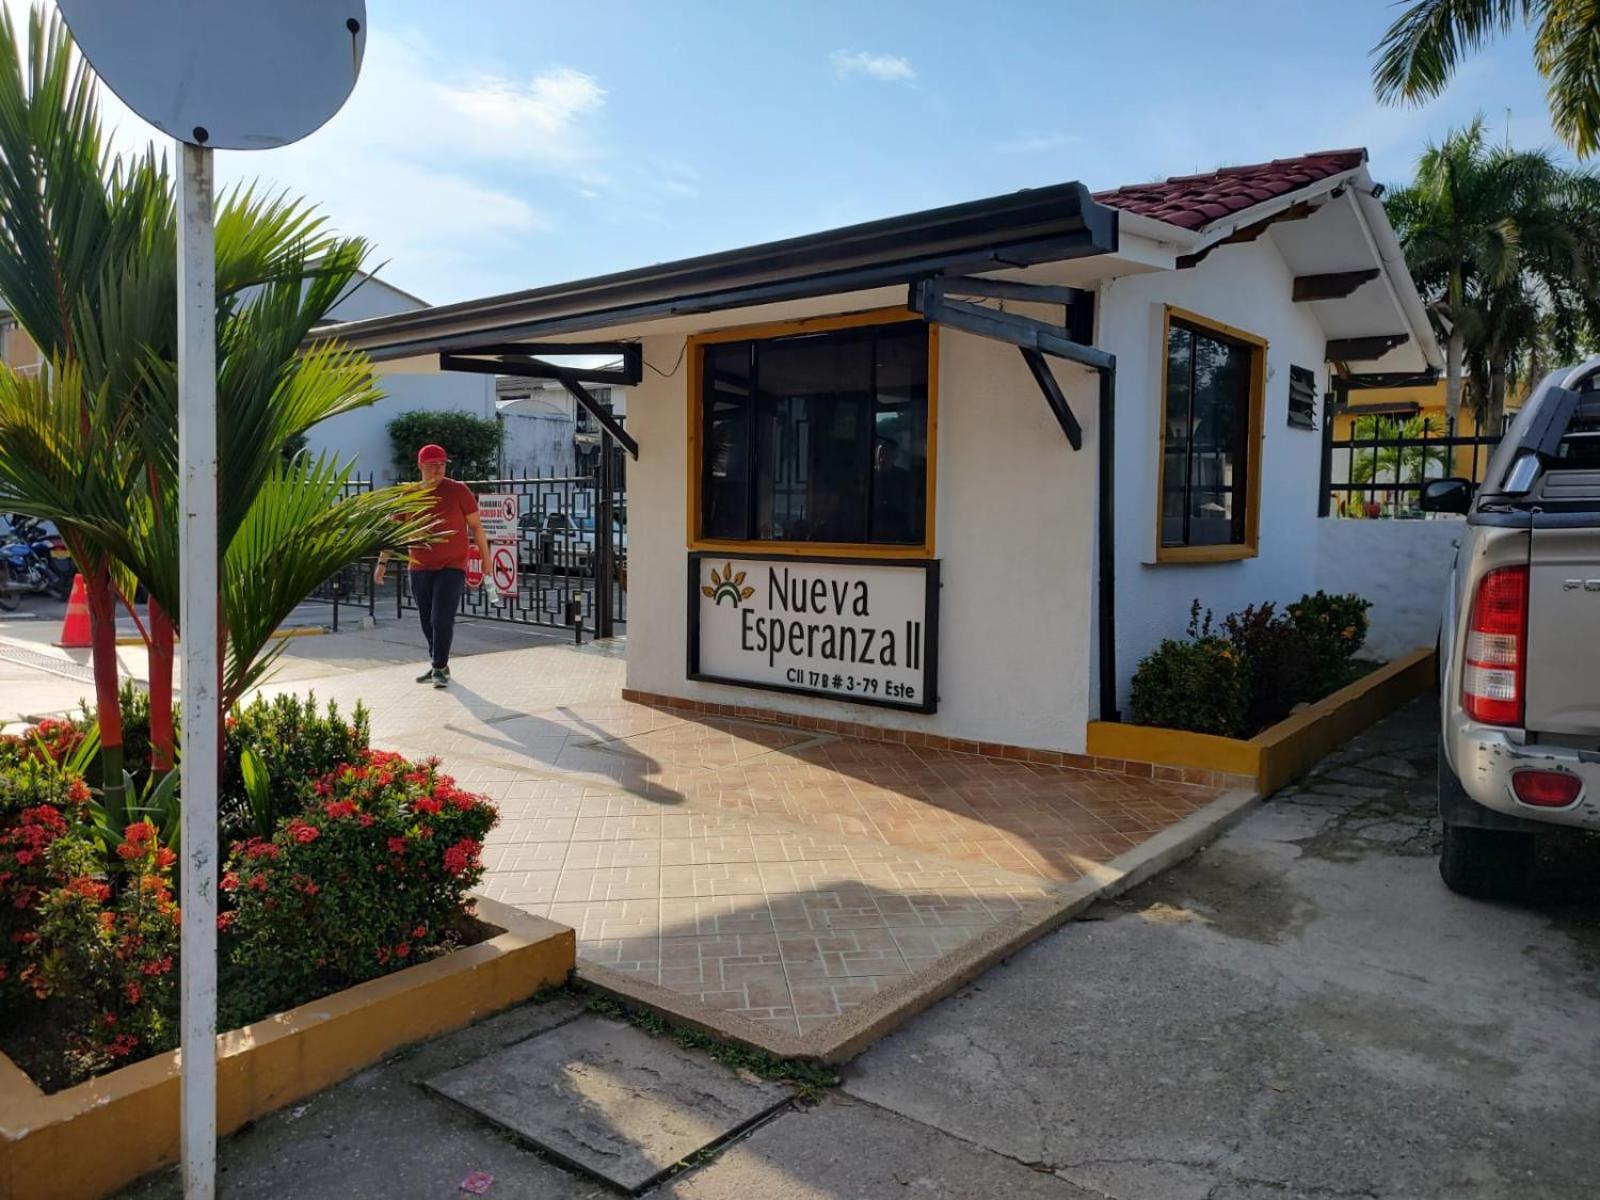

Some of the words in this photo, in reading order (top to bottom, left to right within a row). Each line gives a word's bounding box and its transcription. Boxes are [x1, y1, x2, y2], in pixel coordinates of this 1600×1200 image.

[768, 566, 869, 616] Nueva
[741, 608, 896, 668] Esperanza
[885, 680, 915, 699] Este
